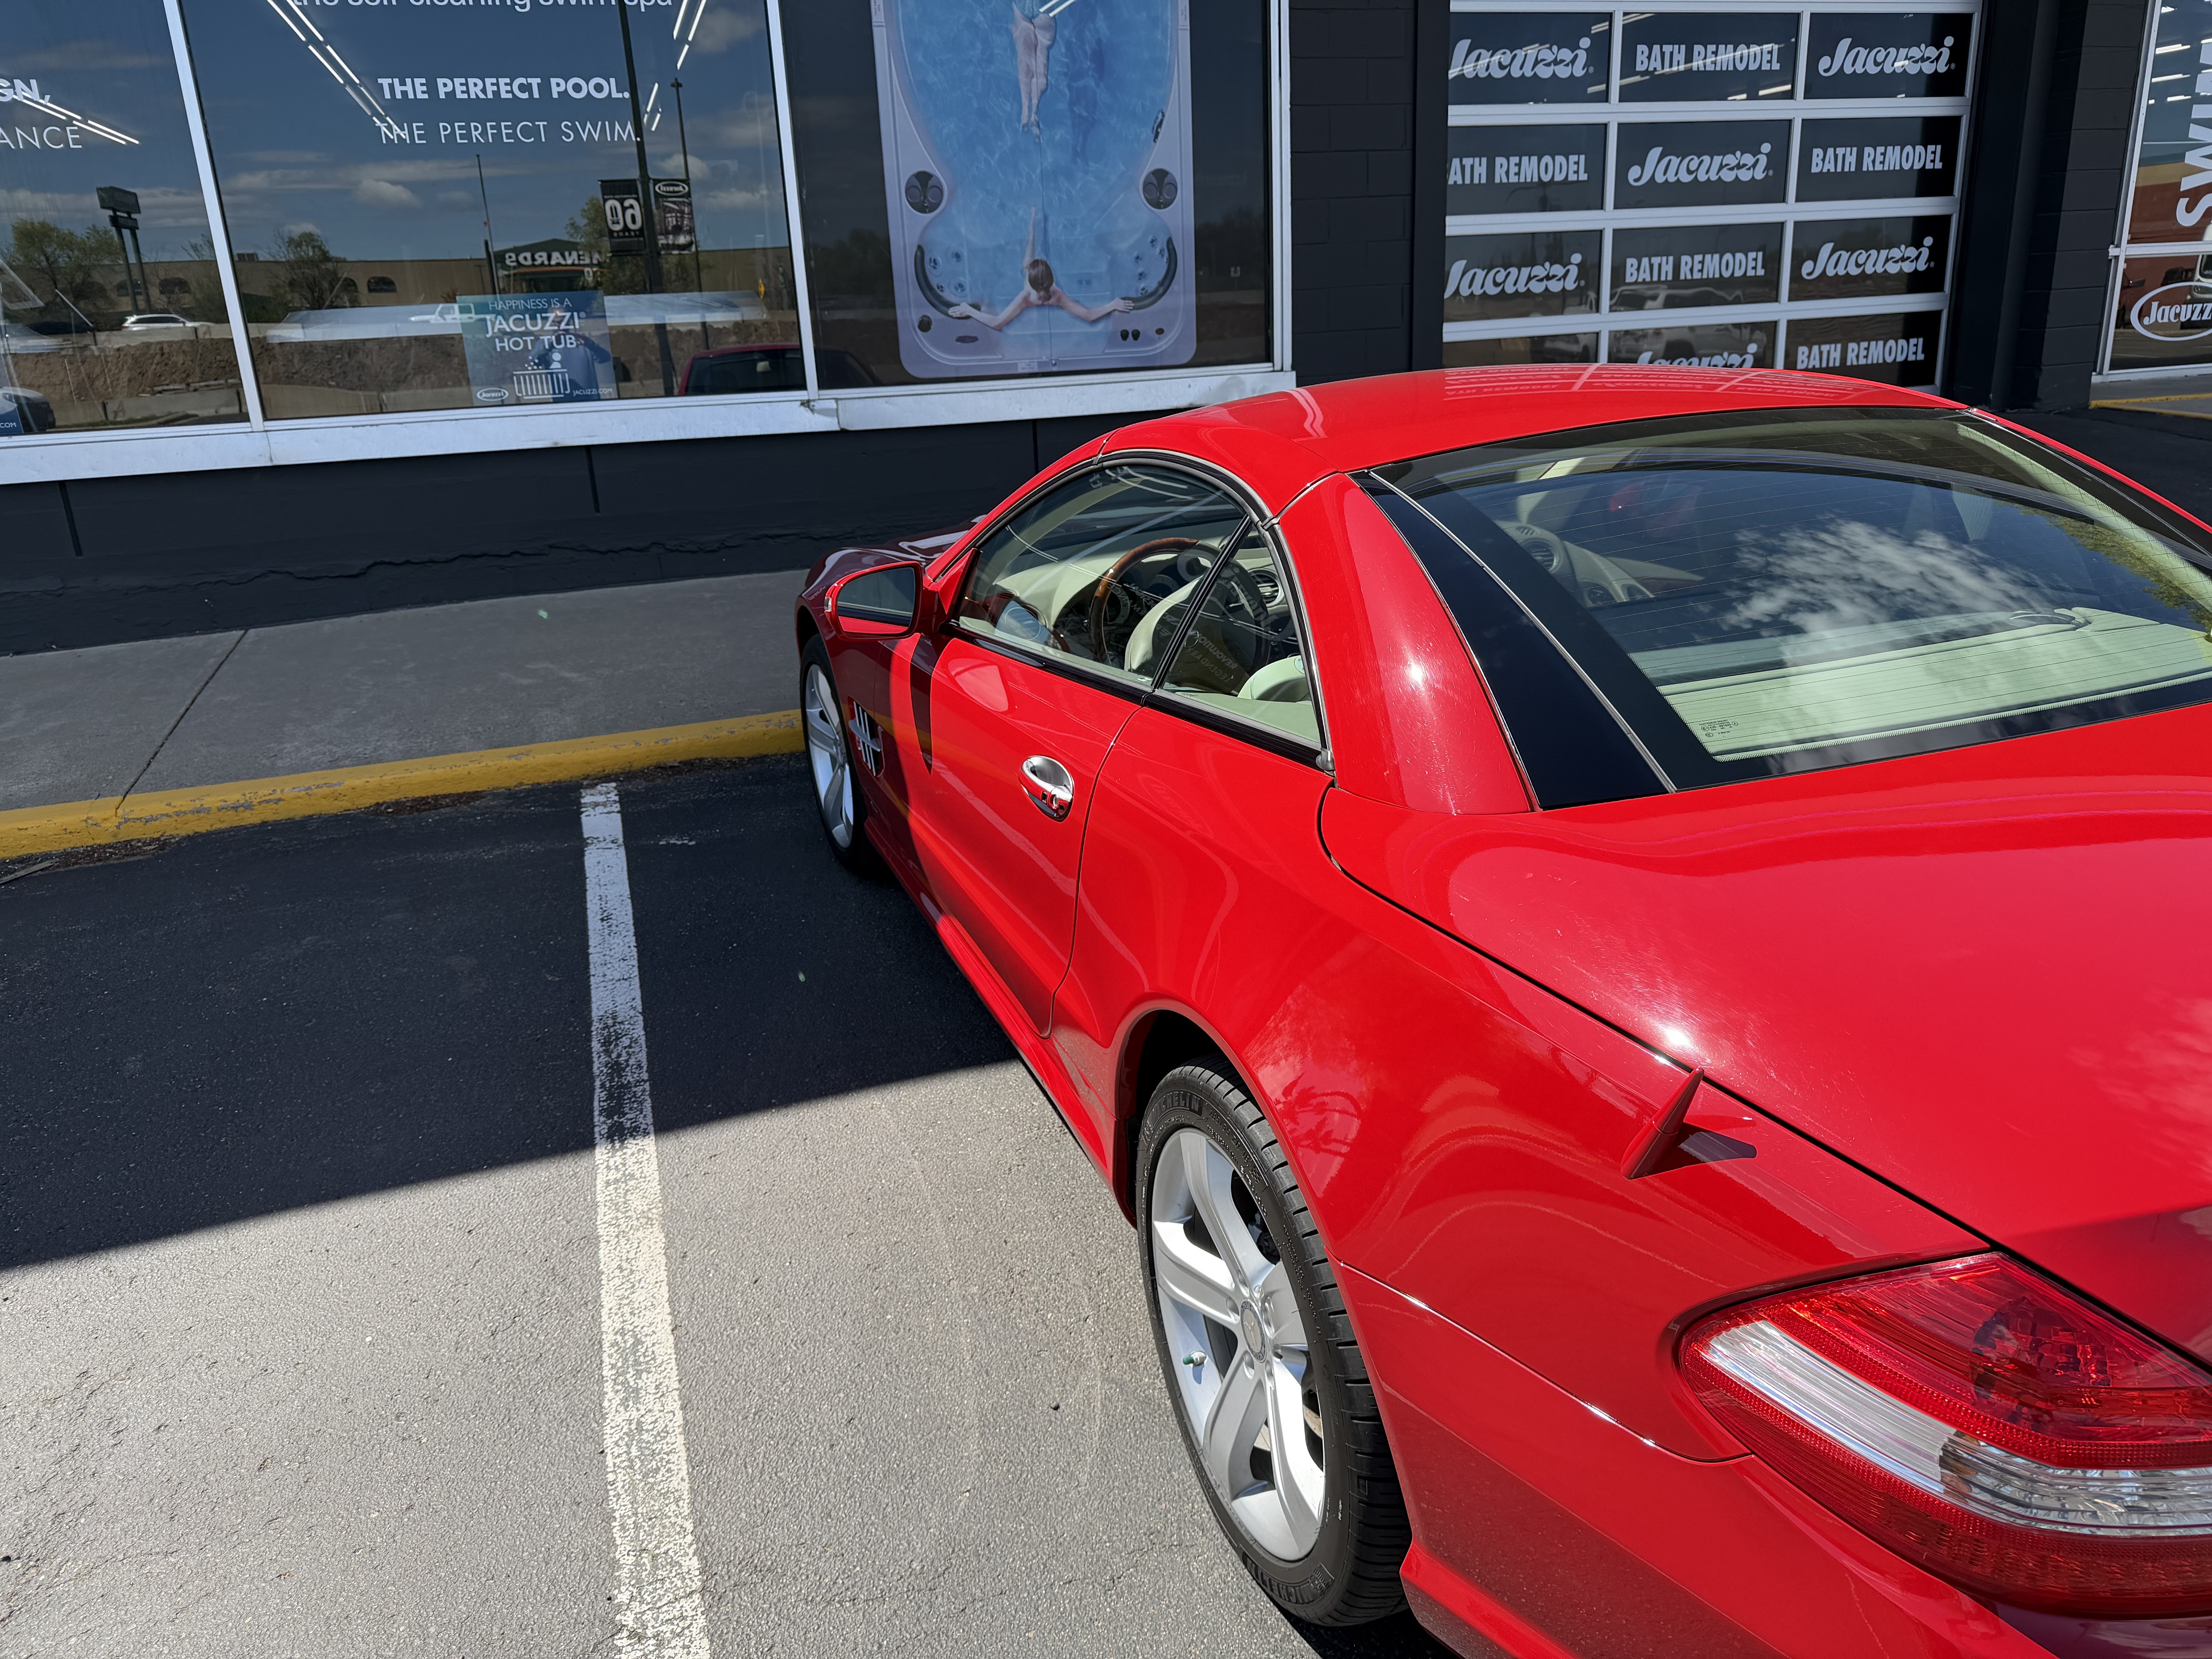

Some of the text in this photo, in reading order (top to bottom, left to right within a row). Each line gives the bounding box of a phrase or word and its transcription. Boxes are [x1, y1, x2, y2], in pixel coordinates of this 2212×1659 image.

[1635, 44, 1781, 72] BATH REMODEL
[377, 77, 630, 99] THE PERFECT POOL.
[375, 122, 426, 144] THE
[439, 121, 548, 143] PERFECT
[1448, 154, 1588, 185] ATH REMODEL
[1810, 144, 1943, 173] BATH REMODEL
[1625, 251, 1765, 283] BATH REMODEL
[489, 297, 572, 311] HAPPINESS IS A
[495, 335, 577, 352] HOT TUB
[1797, 337, 1925, 370] BATH REMODEL
